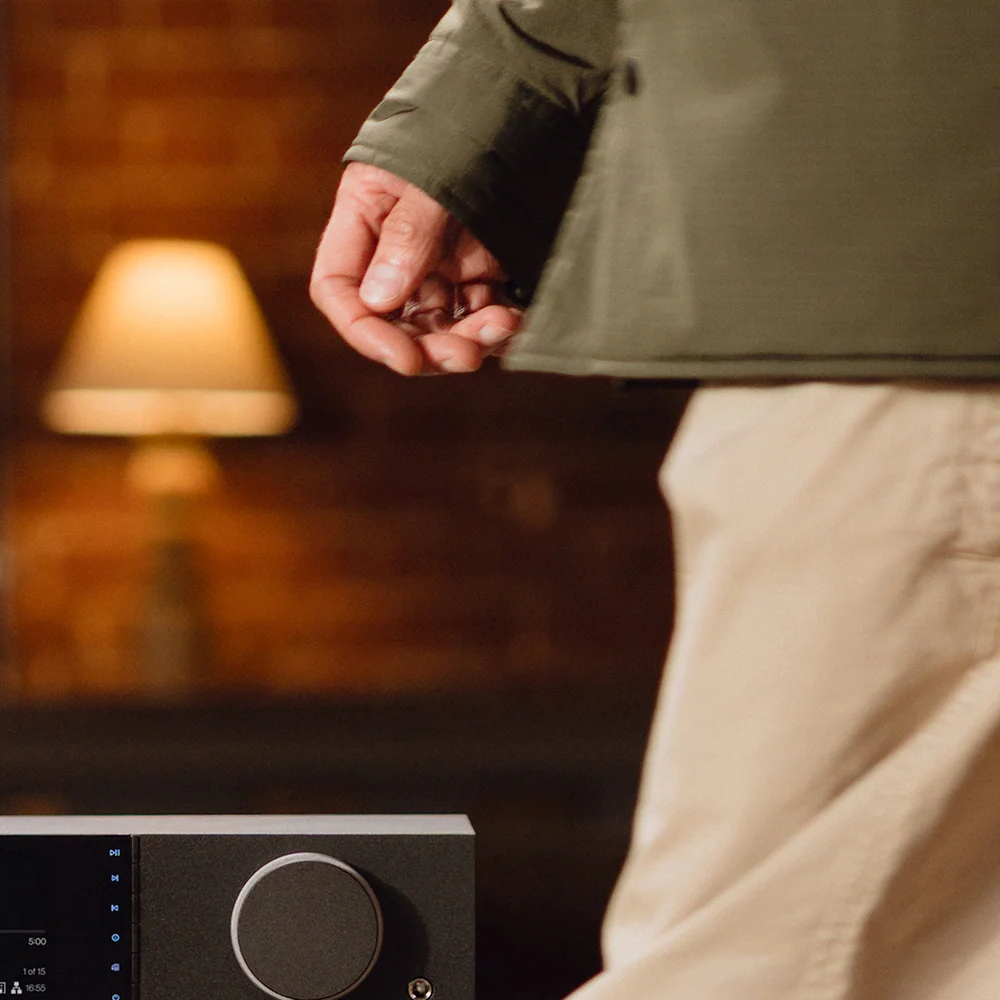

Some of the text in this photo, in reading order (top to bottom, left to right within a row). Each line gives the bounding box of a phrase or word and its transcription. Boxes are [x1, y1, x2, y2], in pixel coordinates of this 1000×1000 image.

[28, 937, 47, 946] 5:00
[27, 967, 36, 976] of
[37, 967, 46, 976] 15
